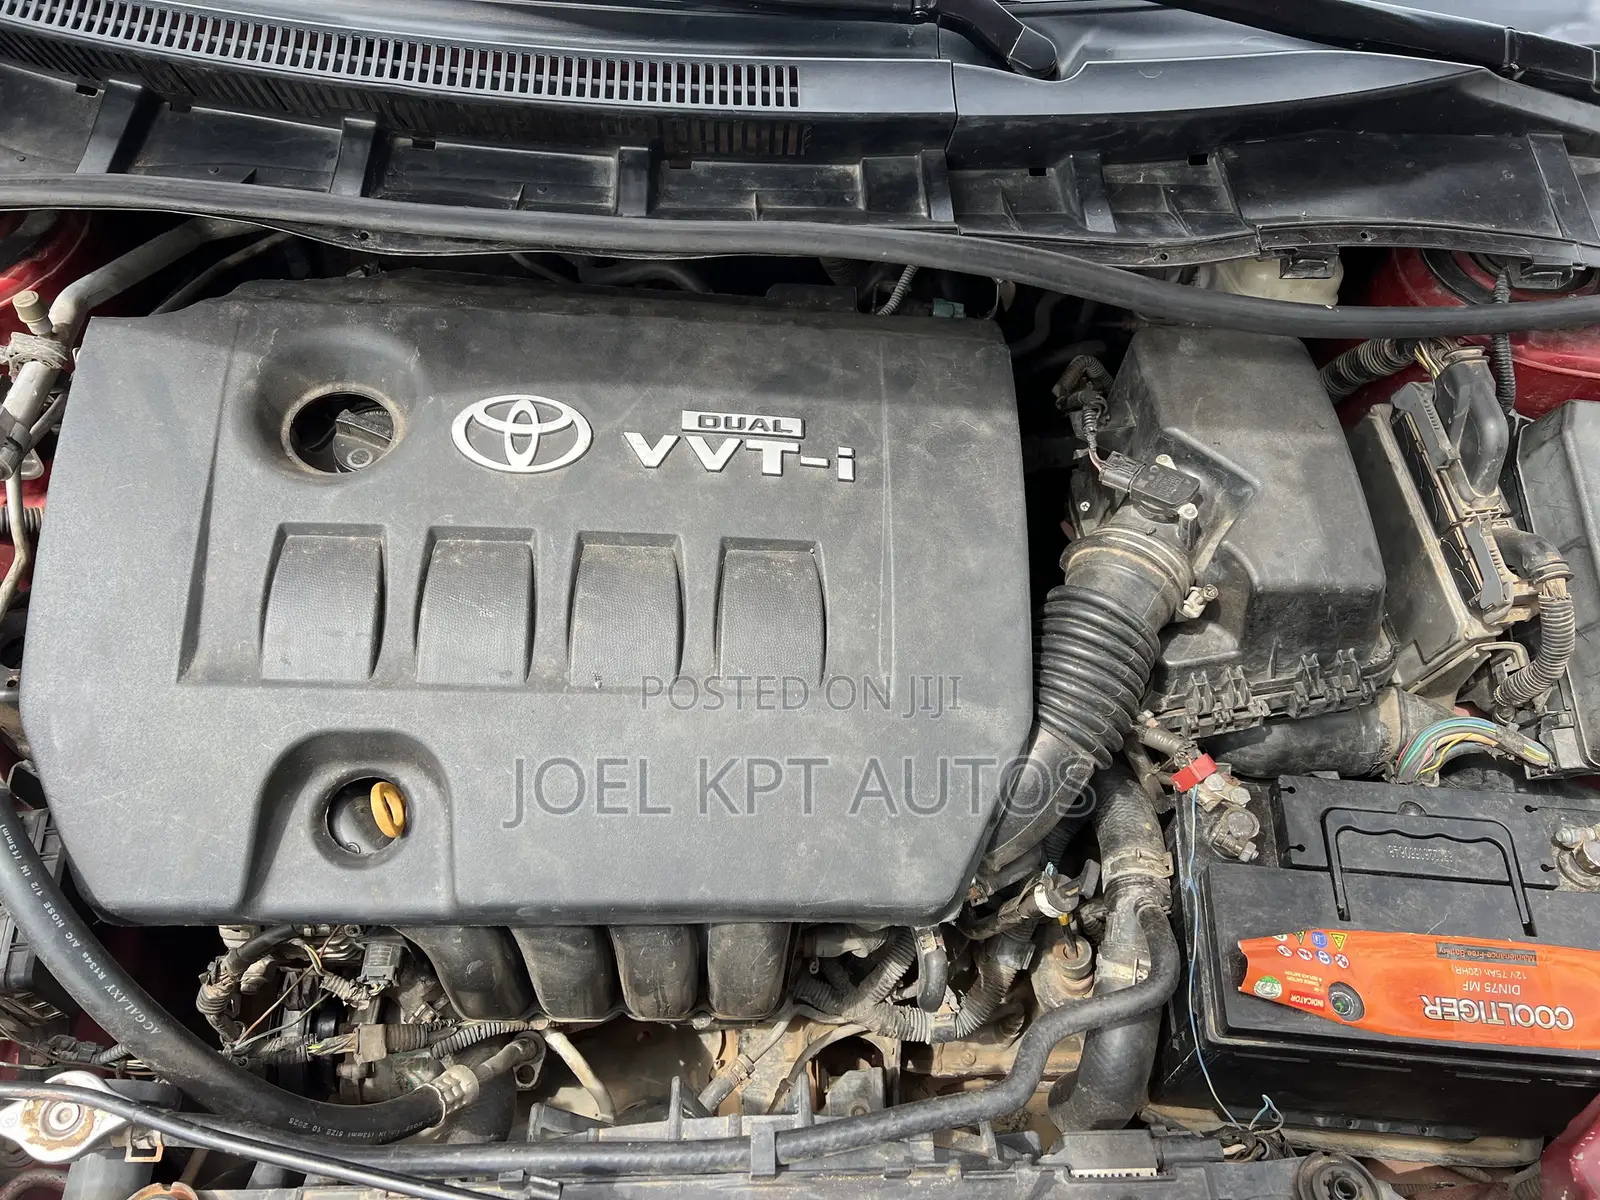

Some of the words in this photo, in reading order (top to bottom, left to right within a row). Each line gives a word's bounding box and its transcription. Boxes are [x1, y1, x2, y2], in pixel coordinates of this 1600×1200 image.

[695, 413, 796, 435] DUAL
[623, 431, 855, 482] VVT-i
[20, 865, 31, 877] IN
[30, 881, 43, 897] 1/2
[43, 901, 65, 929] HOSE
[64, 931, 81, 948] A/C
[1439, 947, 1466, 957] Battery
[82, 951, 106, 981] R134a
[1451, 964, 1482, 977] (20HR)
[1484, 968, 1508, 979] 75Ah
[1511, 971, 1527, 980] 12V
[1462, 980, 1481, 992] MF
[1484, 982, 1521, 996] DIN75
[1290, 994, 1324, 1007] INDICATOR
[1419, 995, 1574, 1031] COOLTIGER
[288, 1117, 308, 1129] 2025
[312, 1124, 321, 1134] 10
[326, 1128, 344, 1138] SIZE
